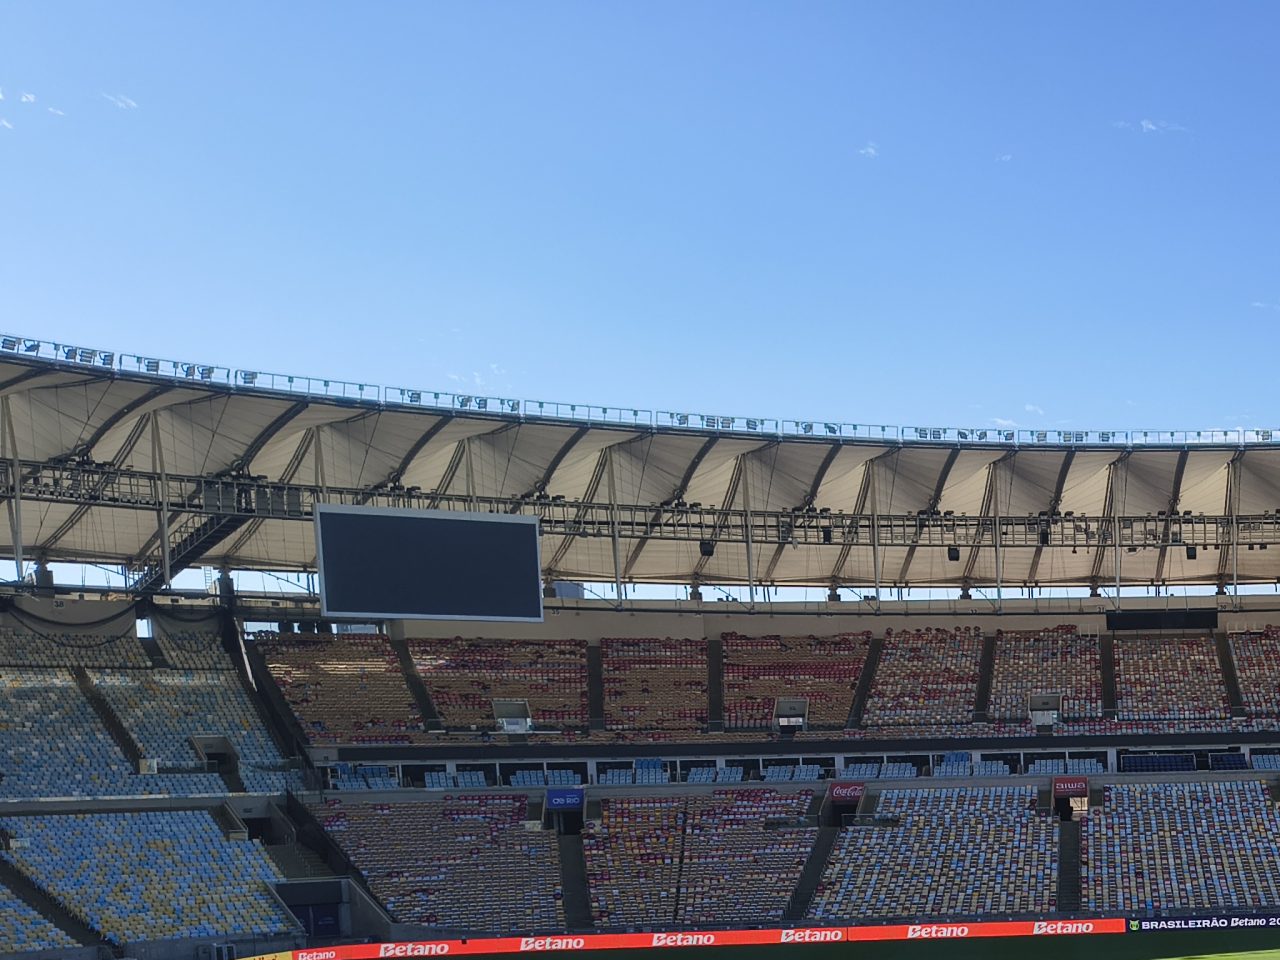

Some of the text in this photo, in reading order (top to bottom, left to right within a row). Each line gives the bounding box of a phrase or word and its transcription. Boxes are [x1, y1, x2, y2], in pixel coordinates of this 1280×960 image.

[1033, 921, 1093, 935] Betano
[1142, 918, 1228, 930] BRASILEIRÃO
[1231, 918, 1266, 927] Betano
[781, 929, 842, 943] Betano
[908, 925, 969, 938] Betano
[520, 937, 584, 951] Betano
[653, 932, 715, 947] Betano
[380, 942, 449, 957] Betano
